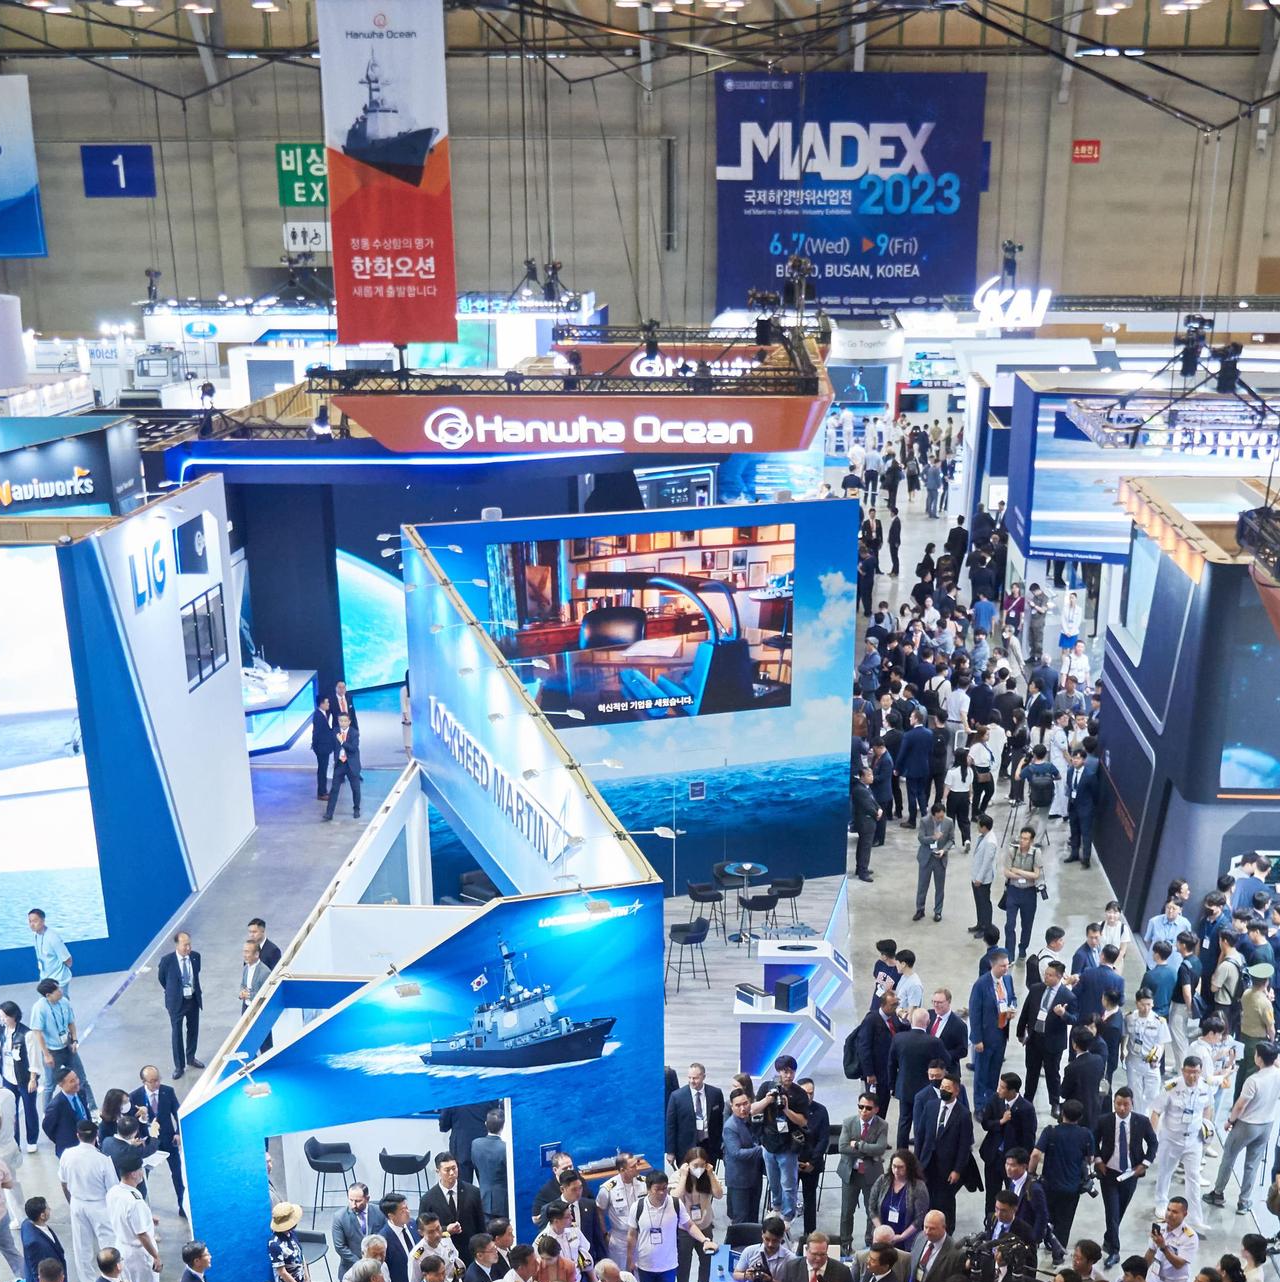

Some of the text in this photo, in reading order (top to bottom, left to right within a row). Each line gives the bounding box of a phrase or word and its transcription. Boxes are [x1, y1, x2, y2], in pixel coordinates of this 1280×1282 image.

[346, 29, 417, 40] Hanwha Ocean
[281, 148, 329, 178] 비상
[716, 121, 936, 181] MADEX
[111, 154, 127, 190] 1
[294, 182, 326, 202] EX
[858, 173, 961, 216] 2023
[351, 255, 436, 280] 한화오션
[825, 264, 873, 280] BUSAN,
[876, 264, 920, 279] KOREA
[976, 280, 1052, 328] KAI
[475, 415, 754, 445] Hanwha Ocean
[128, 538, 166, 609] LIG
[598, 696, 695, 714] 혁신적인 기업을 세웠습니다.
[428, 695, 550, 862] LOCKHEED MARTIN
